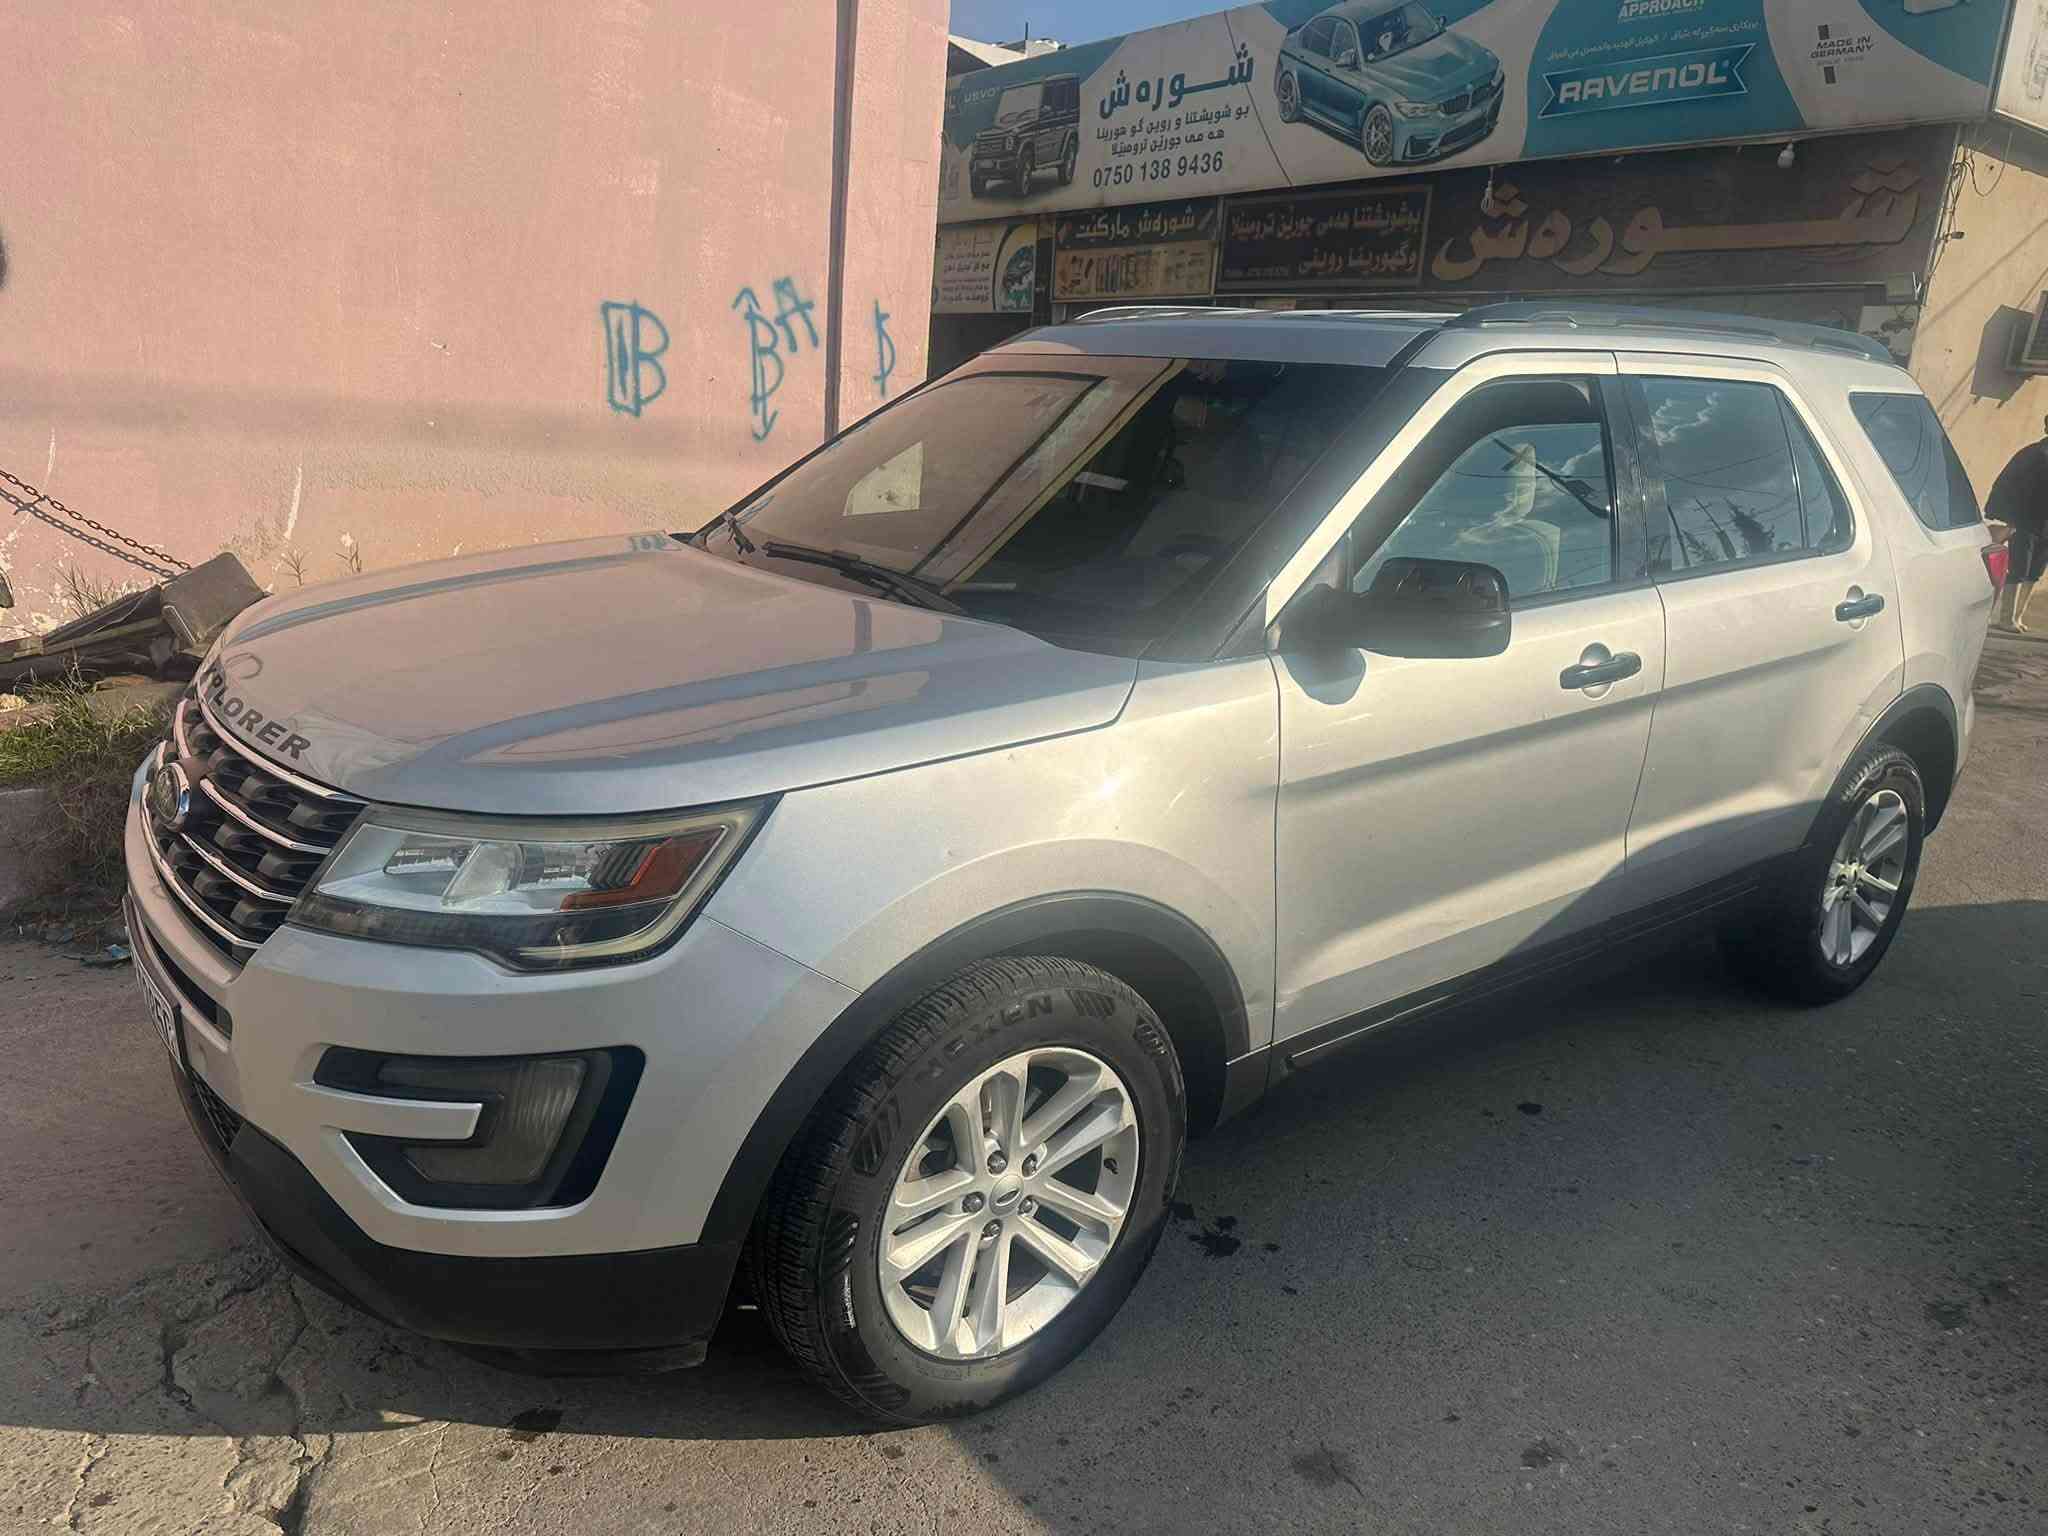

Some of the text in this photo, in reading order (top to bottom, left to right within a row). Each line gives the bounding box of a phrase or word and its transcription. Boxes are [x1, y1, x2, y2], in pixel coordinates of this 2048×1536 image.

[1810, 43, 1875, 59] GERMANY
[1816, 35, 1871, 49] MADE IN
[1558, 62, 1728, 104] RAVENOL
[1092, 151, 1224, 188] 0750 138 9436
